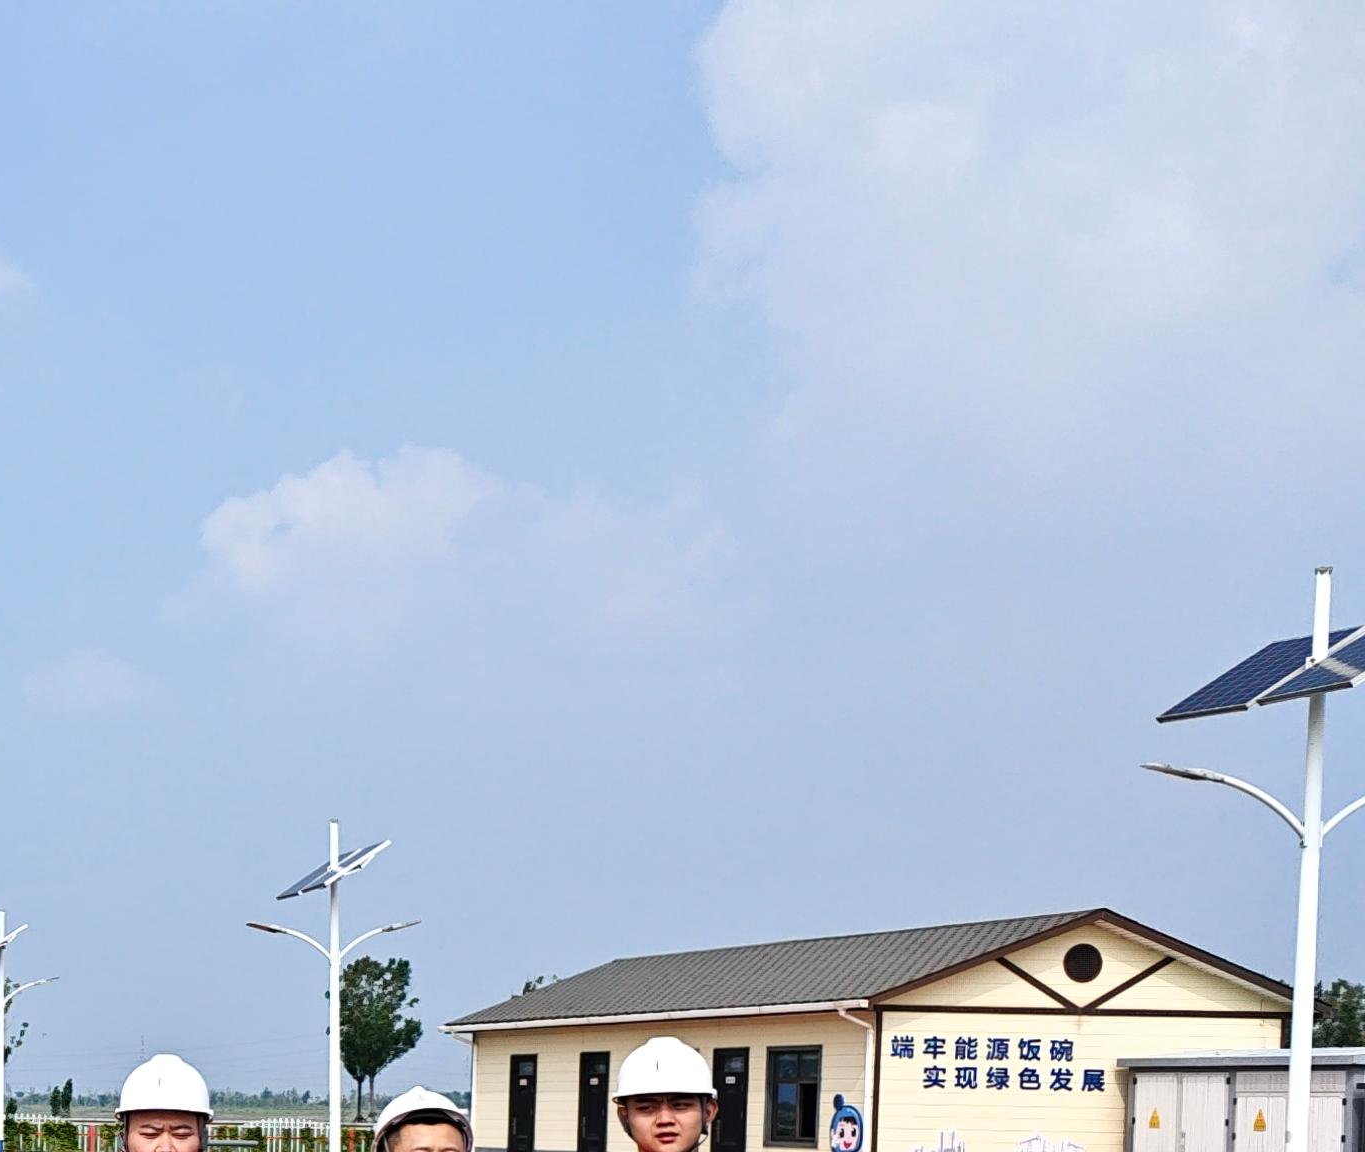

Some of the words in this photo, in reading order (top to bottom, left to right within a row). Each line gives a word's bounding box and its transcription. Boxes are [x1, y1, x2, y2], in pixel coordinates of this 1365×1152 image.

[890, 1035, 1074, 1062] 端牢能源饭碗
[922, 1066, 1105, 1092] 实现绿色发展
